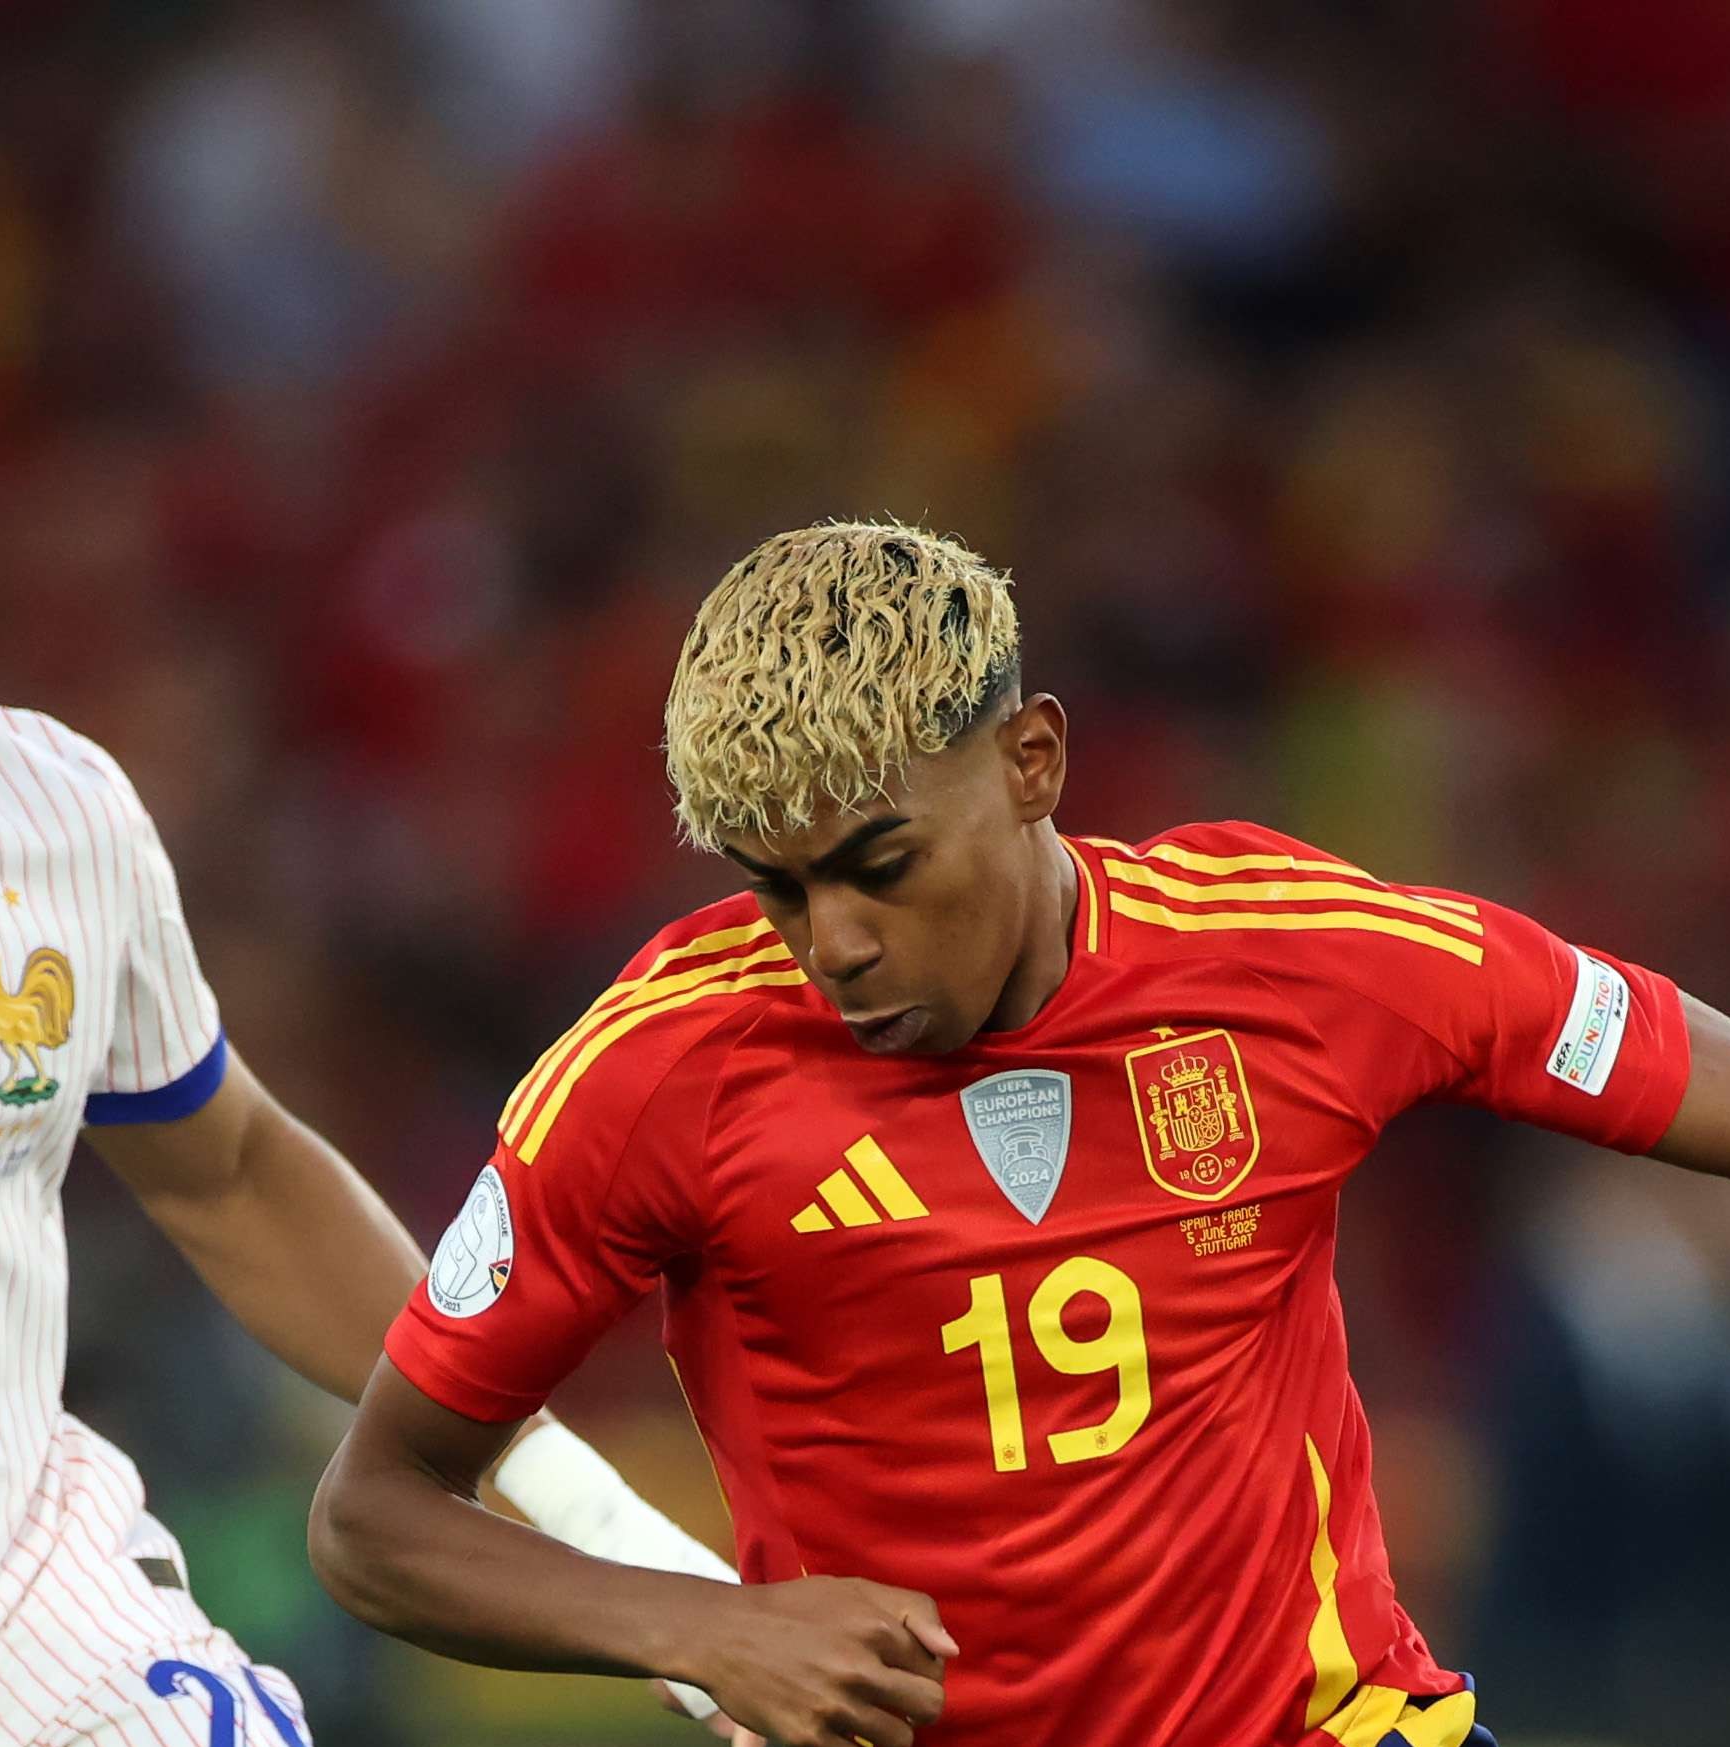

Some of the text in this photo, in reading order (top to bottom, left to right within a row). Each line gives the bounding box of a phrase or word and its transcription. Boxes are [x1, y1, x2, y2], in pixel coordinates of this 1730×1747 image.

[1553, 1042, 1572, 1074] UEFA
[997, 1079, 1032, 1093] UEFA
[974, 1087, 1060, 1114] EUROPEAN
[976, 1102, 1062, 1128] CHAMPIONS
[1009, 1168, 1051, 1188] 2024
[1179, 1215, 1212, 1233] SPAIN
[1222, 1204, 1262, 1224] FRANCE
[1186, 1218, 1257, 1245] 5 JUNE 2025
[1195, 1233, 1253, 1257] STUTTGART
[941, 1256, 1152, 1473] 19
